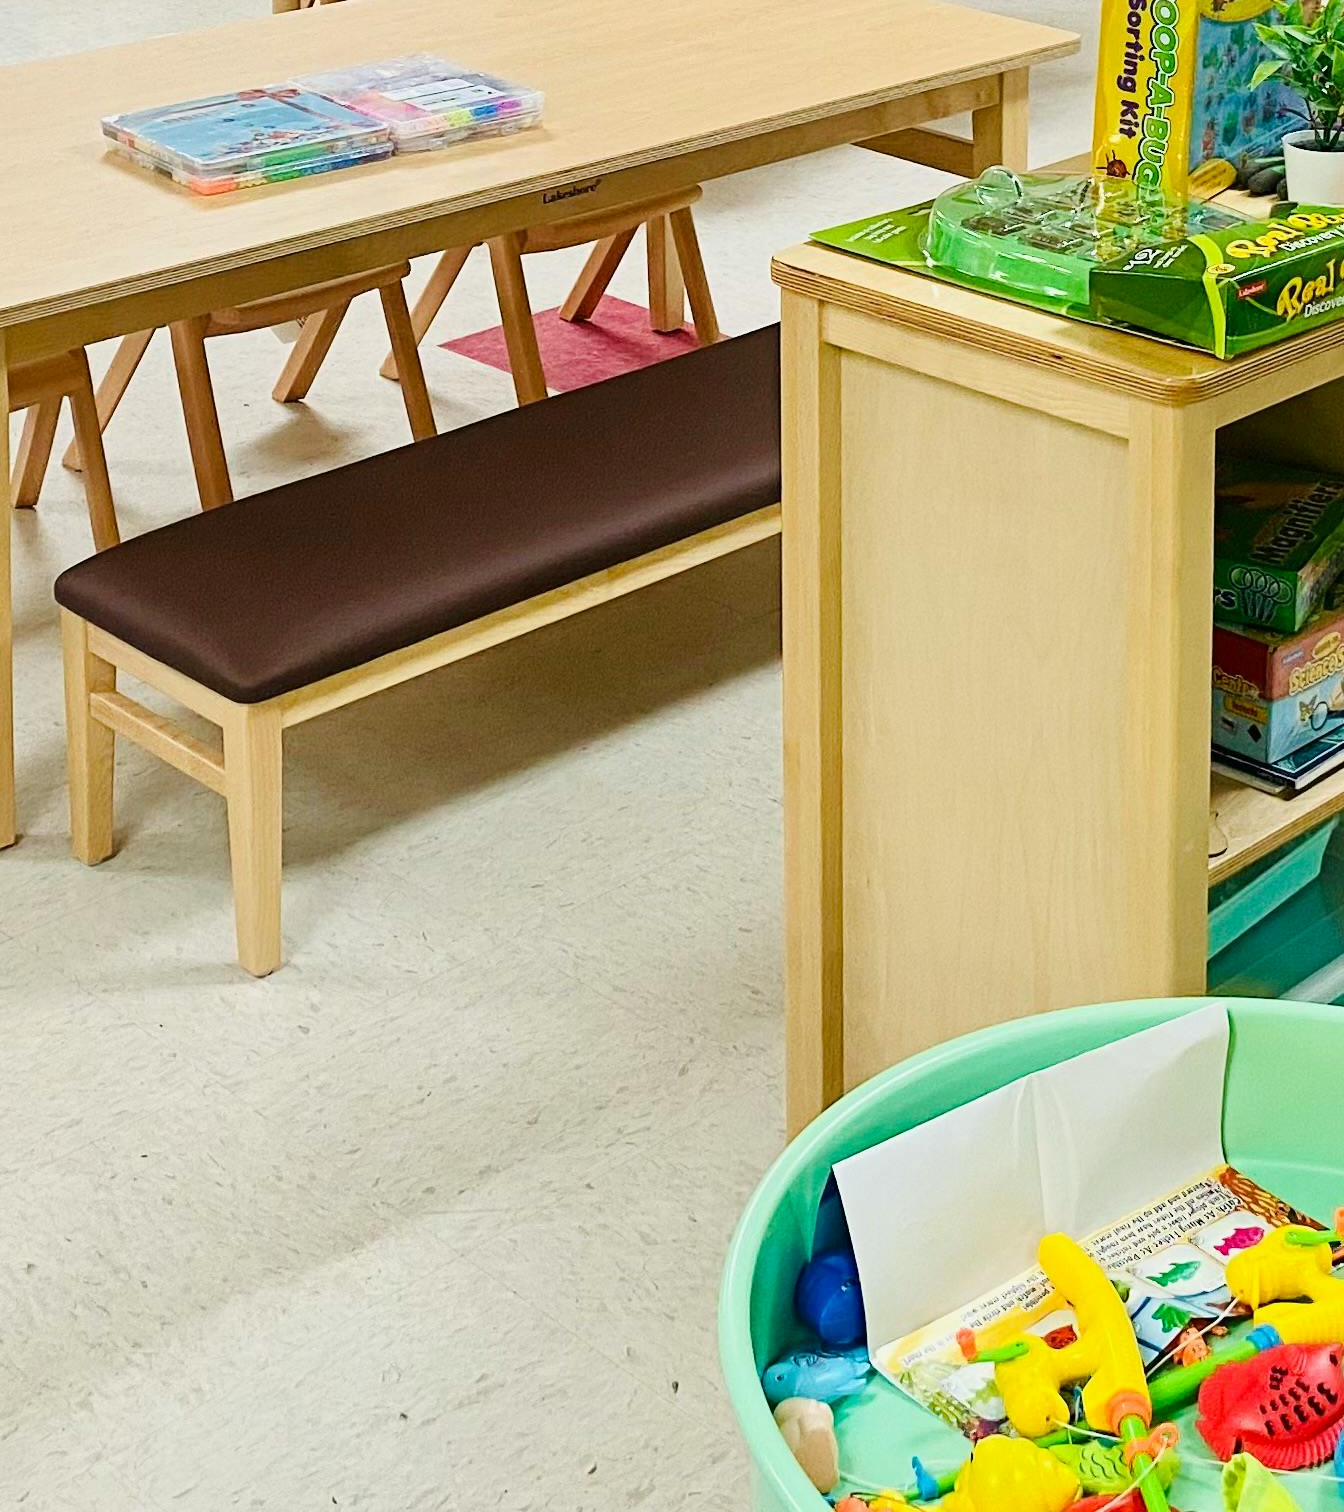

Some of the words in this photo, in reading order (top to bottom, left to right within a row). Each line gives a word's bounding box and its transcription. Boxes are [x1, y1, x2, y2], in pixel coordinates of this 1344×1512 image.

[1119, 99, 1141, 140] Kit
[1225, 221, 1306, 259] Real
[1277, 259, 1336, 322] Real
[1289, 651, 1338, 694] Science
